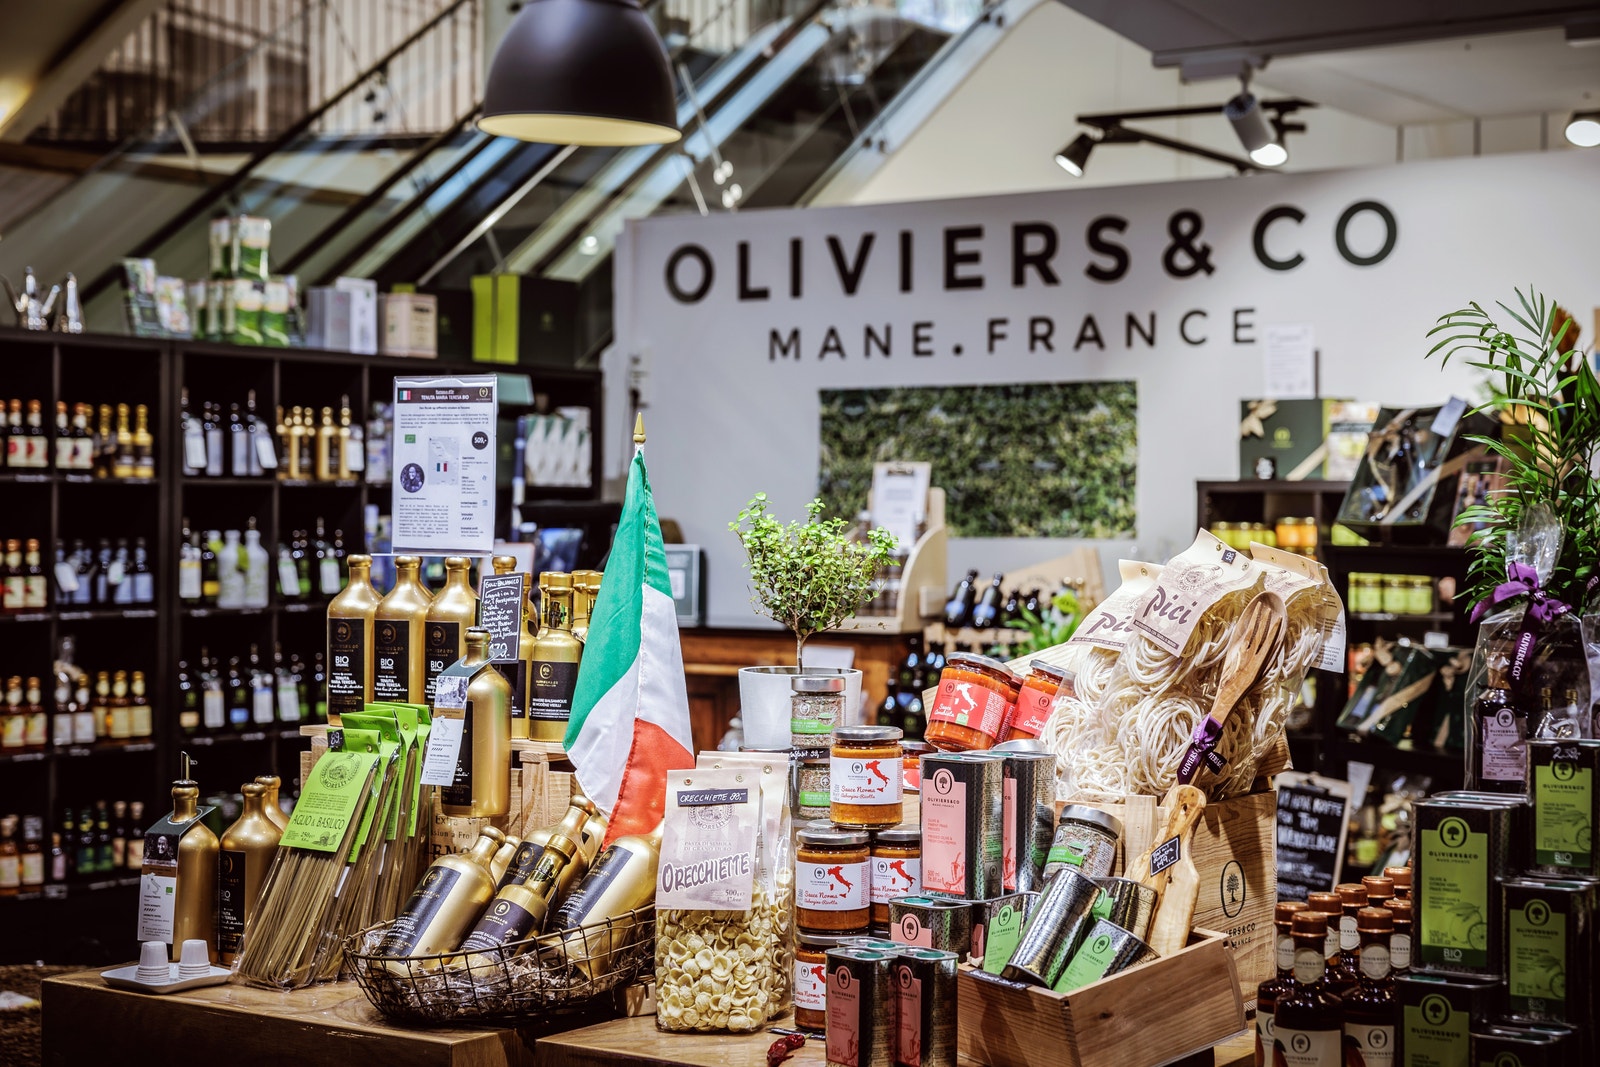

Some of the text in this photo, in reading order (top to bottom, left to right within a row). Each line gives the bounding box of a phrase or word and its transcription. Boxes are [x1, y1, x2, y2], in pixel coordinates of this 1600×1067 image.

[380, 658, 394, 666] BIO
[430, 660, 444, 668] BIO
[939, 703, 951, 711] Sauce
[841, 785, 876, 793] Sauce Norma
[928, 797, 960, 805] OLIVIERS&CO
[1313, 798, 1343, 816] KAFFE
[292, 815, 310, 826] AGLIO
[317, 816, 346, 830] BASILICO
[1429, 851, 1479, 860] OLIVIERS&CO
[1554, 852, 1572, 861] BIO
[882, 885, 899, 893] Norma
[804, 890, 838, 899] Sauce Norma
[1228, 922, 1256, 938] ERS&CO
[1443, 948, 1463, 958] BIO
[804, 990, 820, 998] Norma
